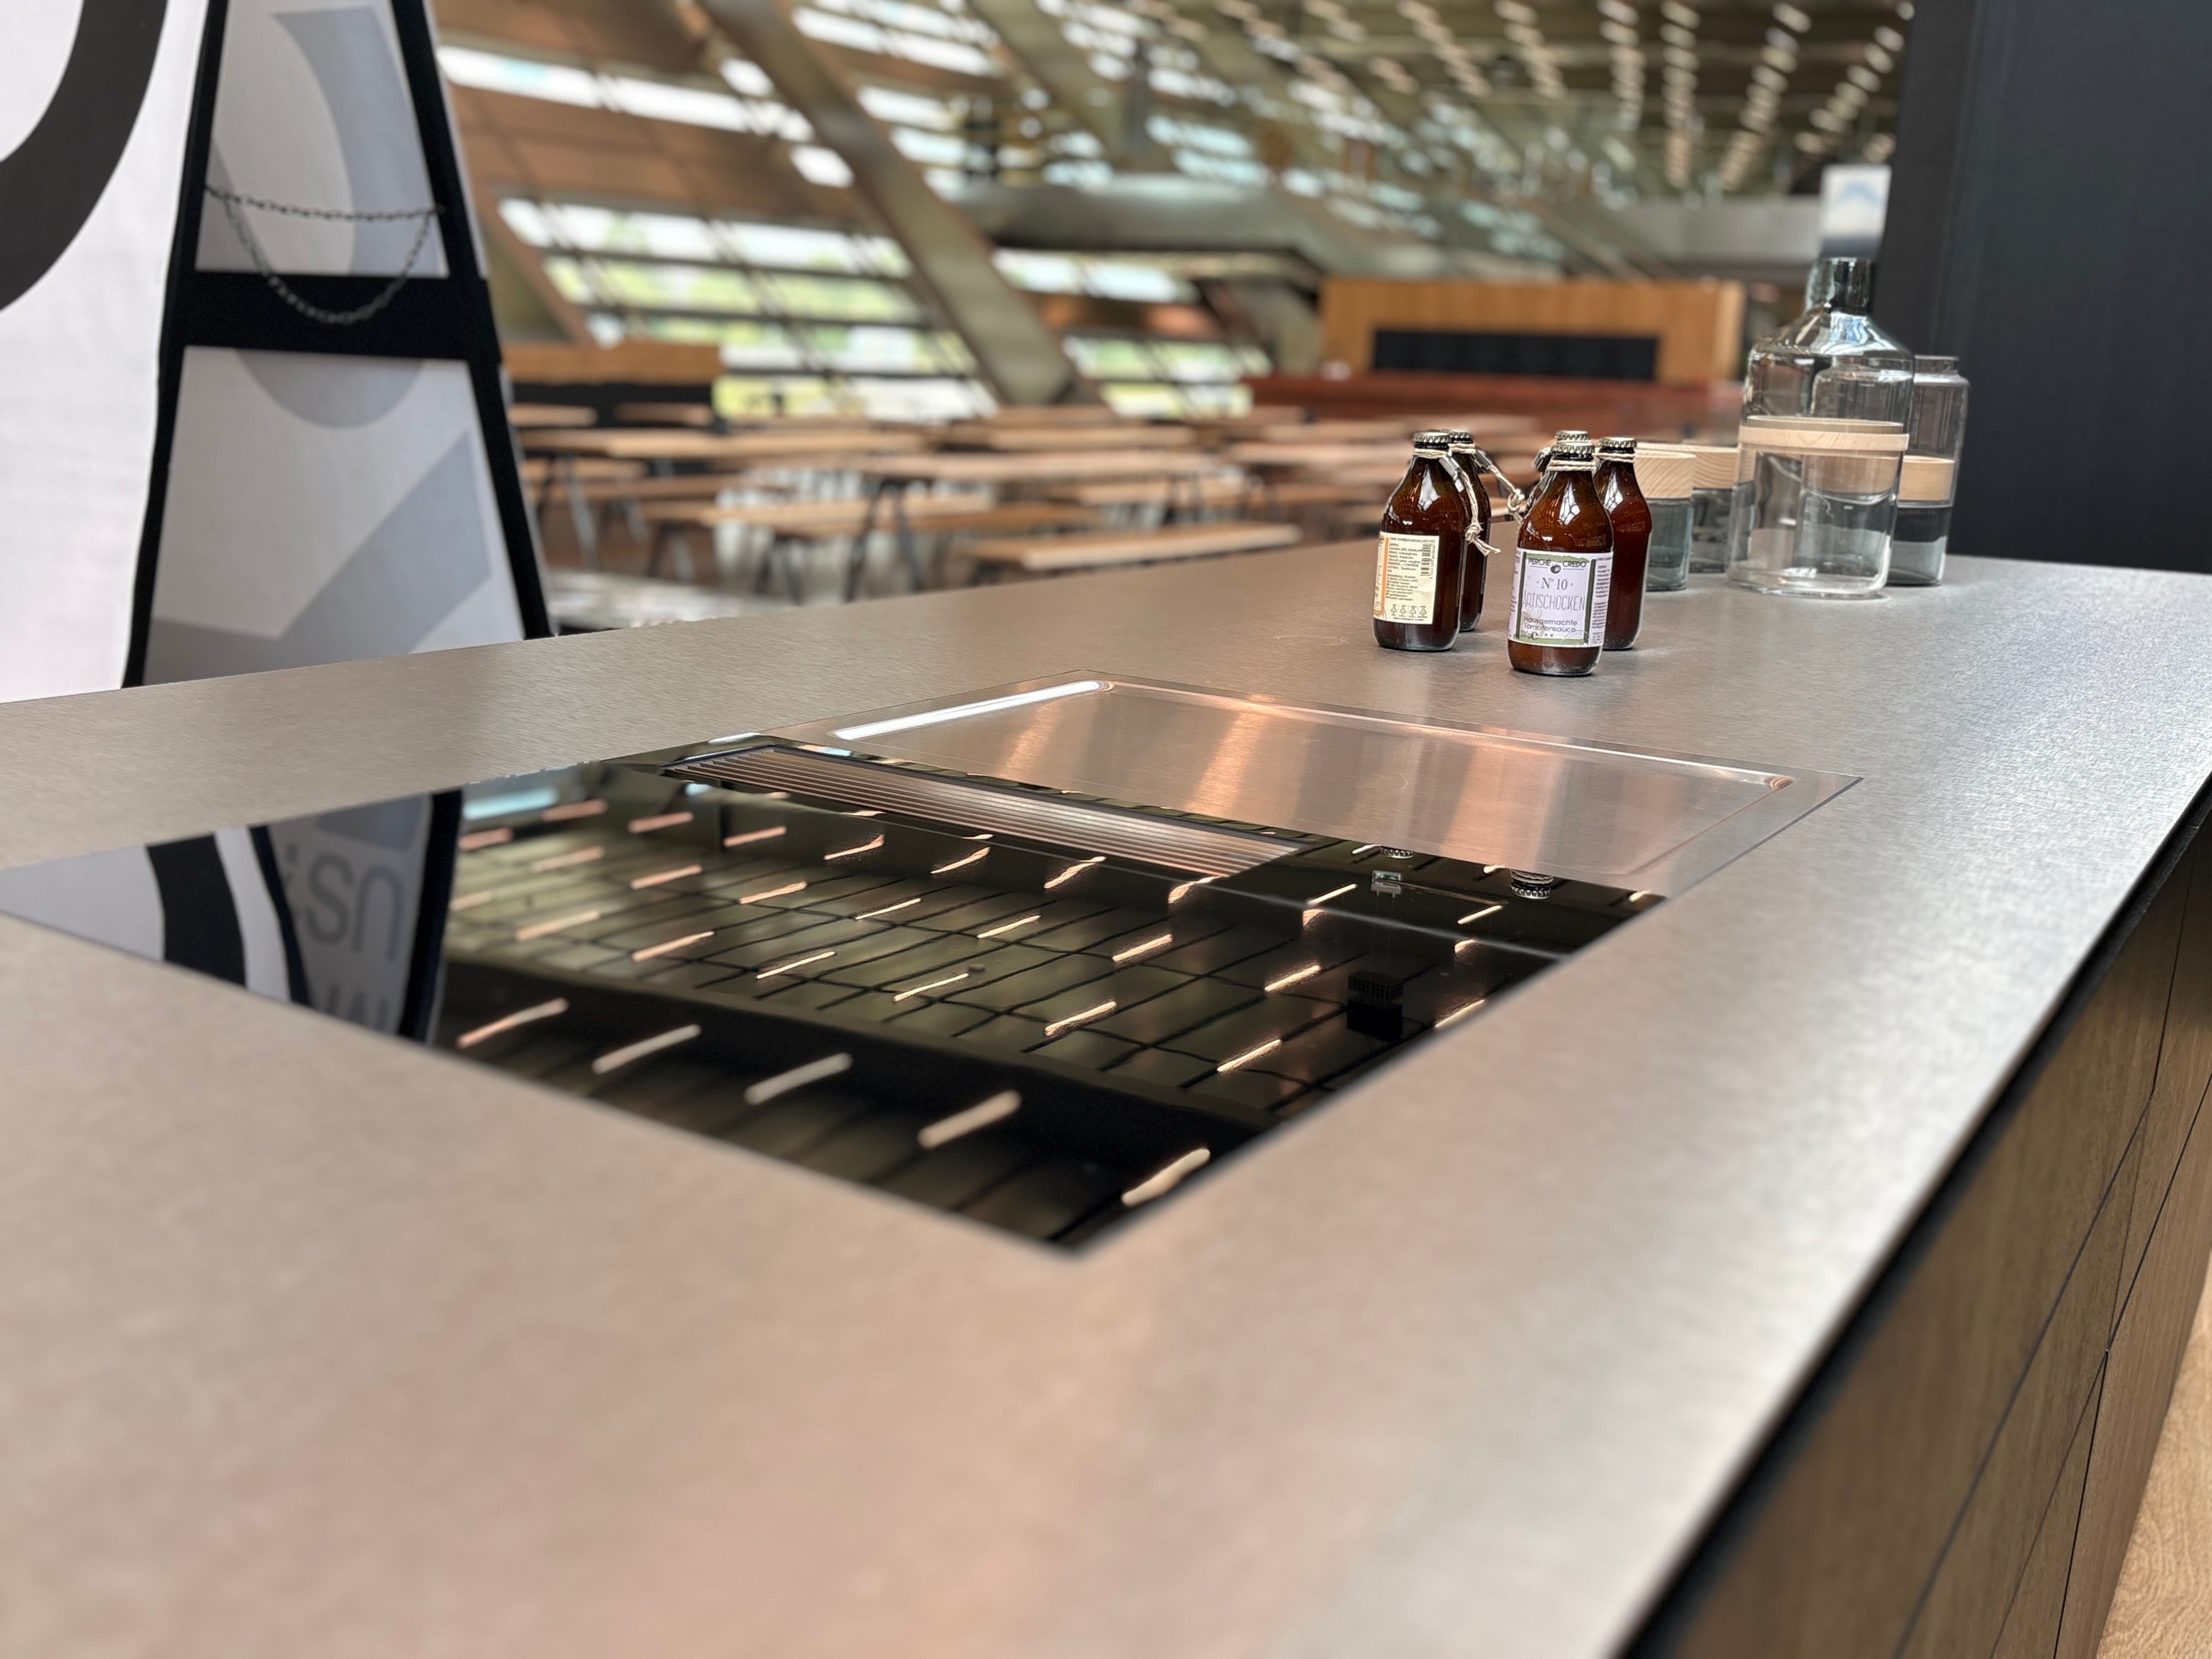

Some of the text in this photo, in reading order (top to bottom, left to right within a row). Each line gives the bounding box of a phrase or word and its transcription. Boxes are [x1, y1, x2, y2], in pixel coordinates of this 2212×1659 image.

[1528, 557, 1551, 566] PERCHÉ
[1556, 579, 1568, 590] 10
[1522, 590, 1585, 611] ARTISCHOCKEN
[1523, 616, 1578, 626] Hausgemachte
